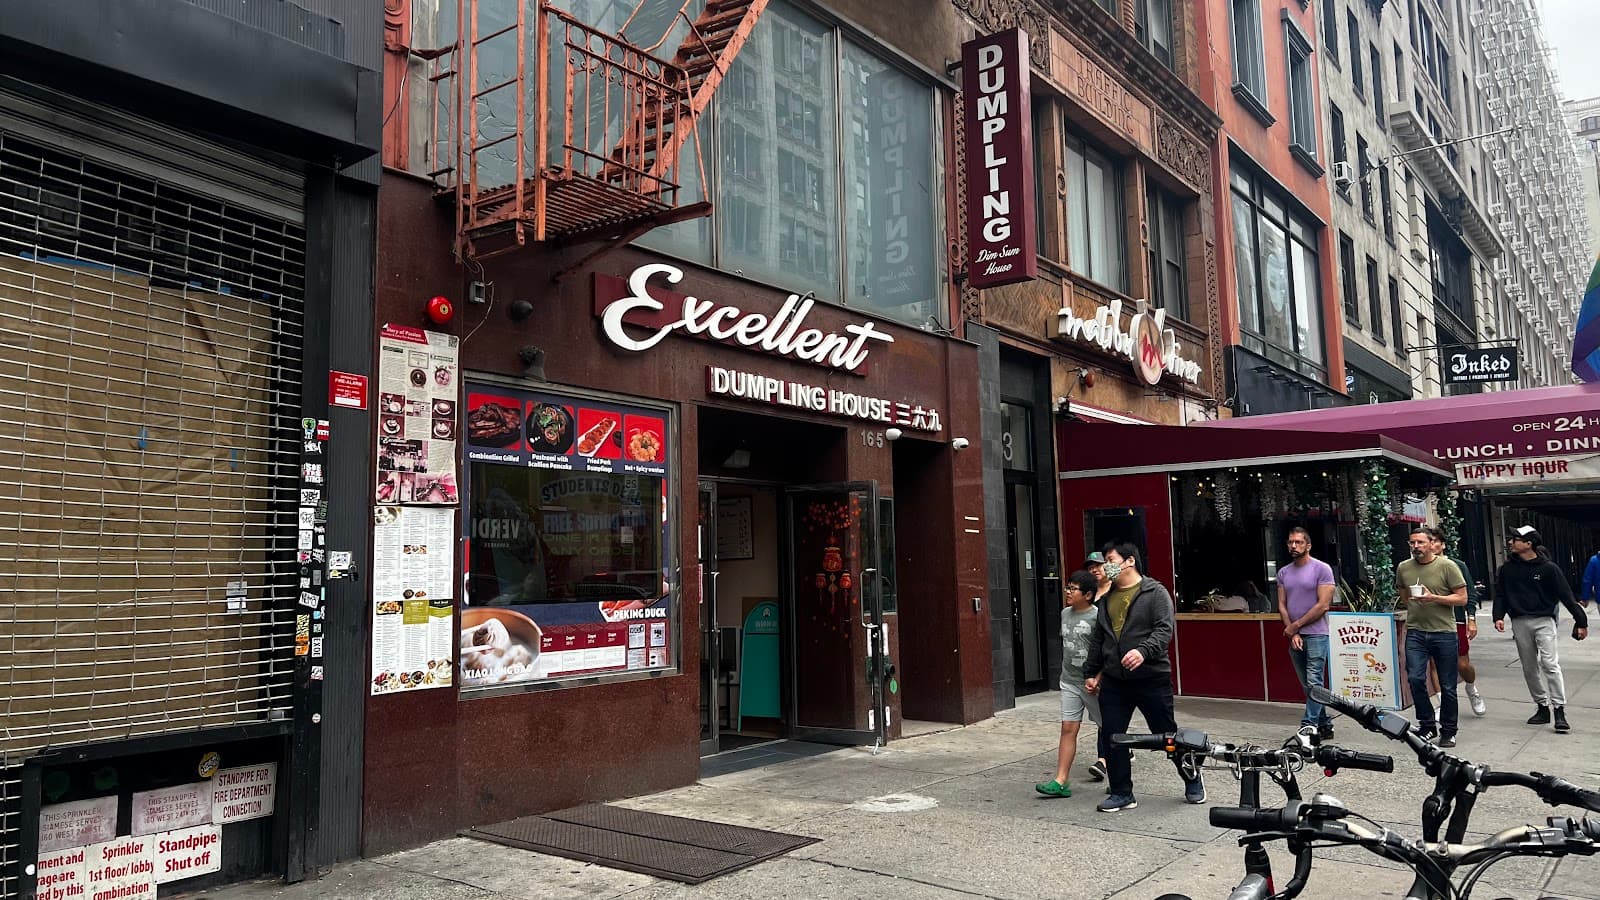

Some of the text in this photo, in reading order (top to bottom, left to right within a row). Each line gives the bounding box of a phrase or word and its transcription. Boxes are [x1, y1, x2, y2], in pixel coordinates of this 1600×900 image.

[1077, 52, 1133, 112] TRAFFIC
[977, 44, 1011, 243] DUMPLING
[975, 245, 1021, 263] Dim Sum
[983, 262, 1013, 276] House
[602, 263, 895, 370] Excellent
[1451, 353, 1511, 374] Inked
[711, 367, 892, 421] DUMPLING HOUSE
[895, 402, 943, 431] 三六九
[1512, 415, 1600, 433] OPEN 24 H
[861, 430, 883, 448] 165
[1003, 432, 1014, 461] 3
[557, 455, 569, 463] with
[1433, 443, 1514, 460] LUNCH
[1463, 459, 1569, 479] HAPPY HOUR
[543, 478, 610, 501] STUDENTS
[613, 607, 667, 619] PEKING DUCK
[1337, 625, 1384, 638] HAPPY
[1341, 635, 1378, 647] HOUR
[465, 668, 488, 679] XIAO
[1352, 690, 1361, 698] $7
[218, 768, 269, 787] STANDPIPE FOR
[214, 783, 271, 804] FIRE DEPARTMENT
[223, 799, 262, 819] CONNECTION
[102, 841, 144, 861] Sprinkler
[159, 832, 217, 855] Standpipe
[38, 850, 84, 870] ment and
[165, 851, 211, 873] Shut off
[36, 871, 76, 888] rage are
[89, 859, 154, 883] 1st floor/ lobby
[53, 887, 65, 900] by
[66, 882, 84, 897] this
[93, 882, 149, 900] combination
